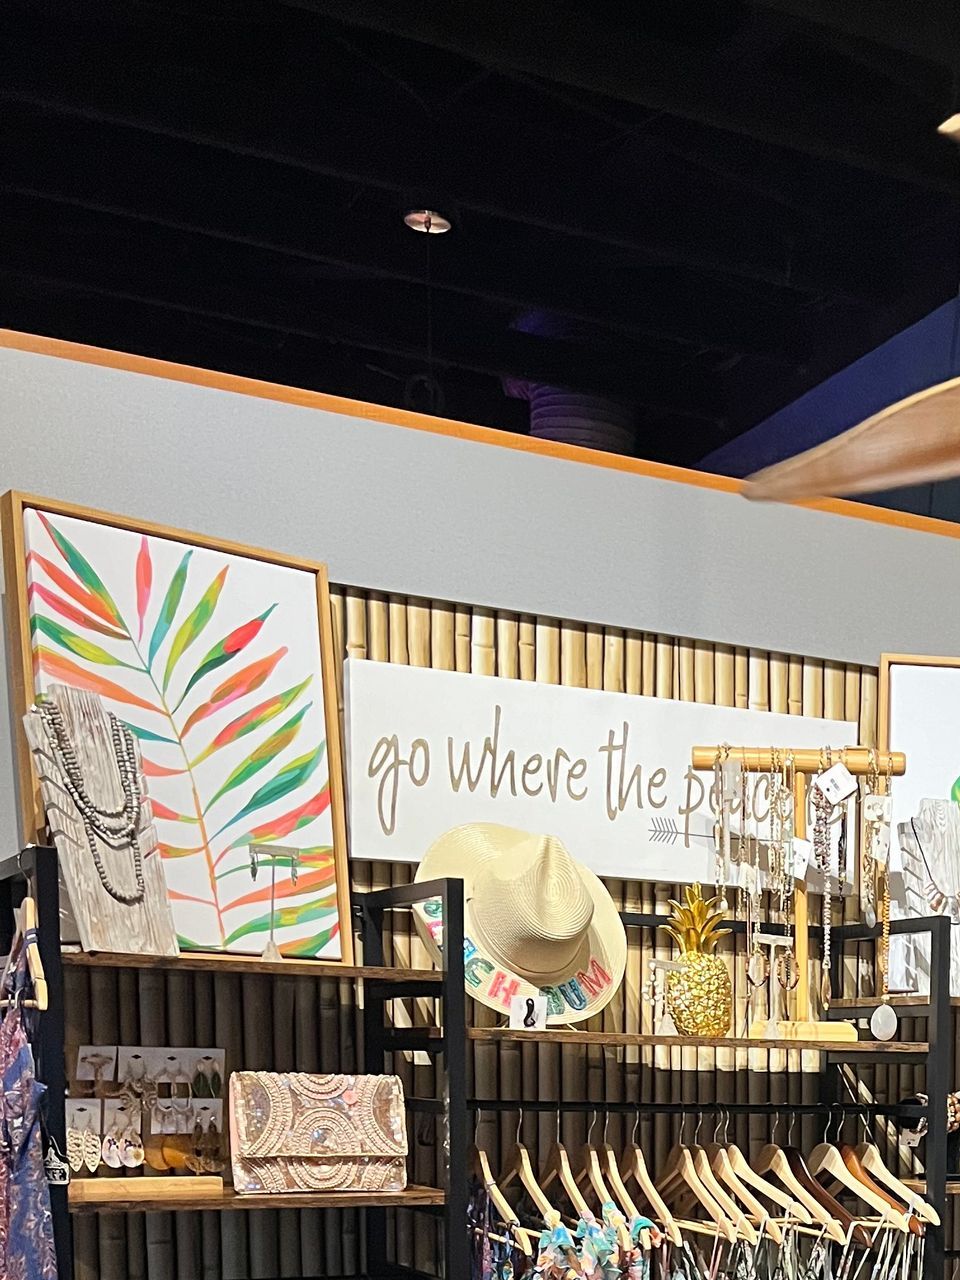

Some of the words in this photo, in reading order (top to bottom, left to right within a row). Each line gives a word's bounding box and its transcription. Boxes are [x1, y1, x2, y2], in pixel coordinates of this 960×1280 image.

[367, 733, 430, 836] go
[447, 704, 588, 803] where
[598, 720, 667, 821] the
